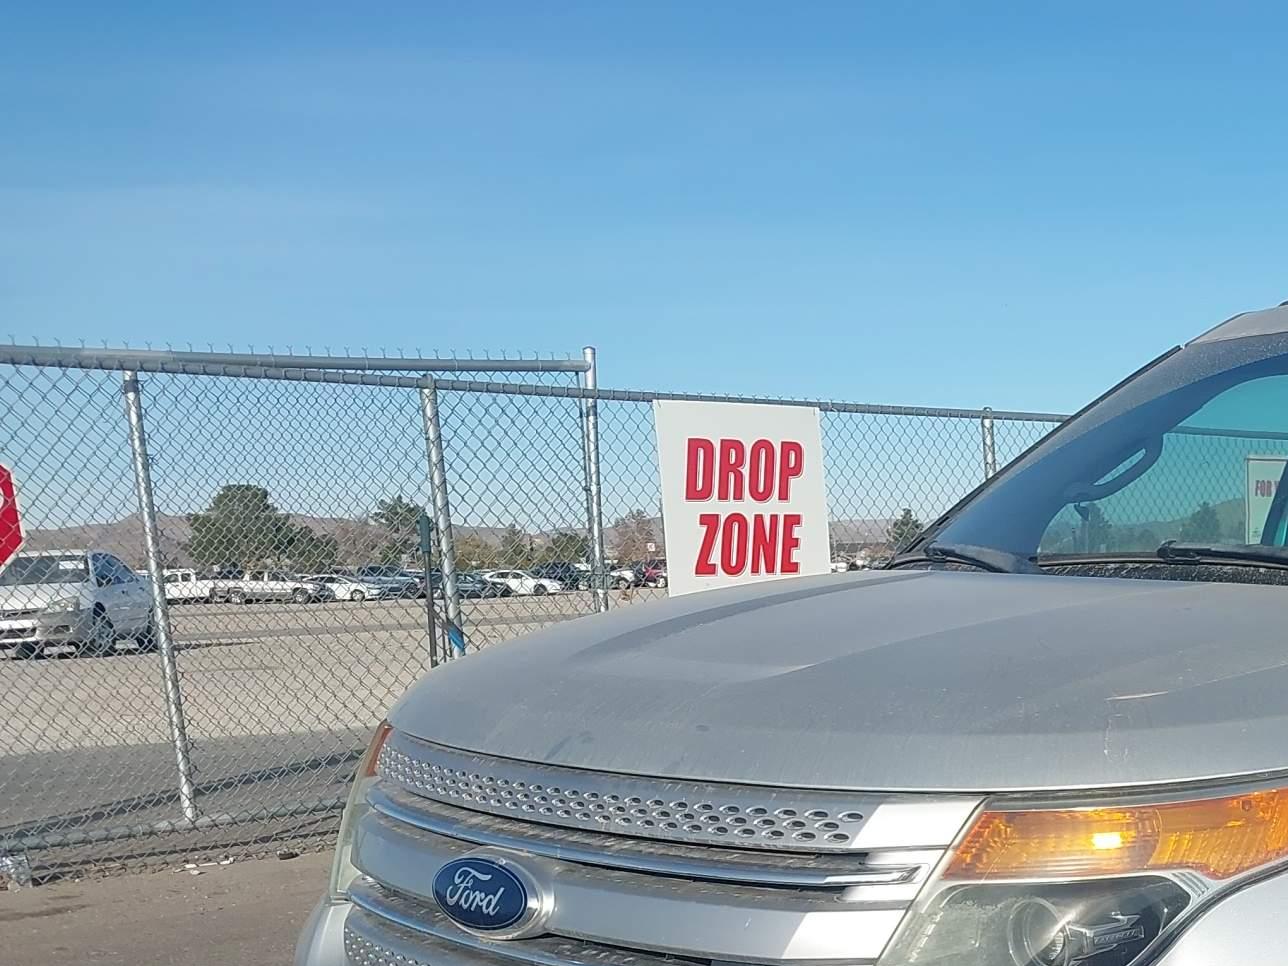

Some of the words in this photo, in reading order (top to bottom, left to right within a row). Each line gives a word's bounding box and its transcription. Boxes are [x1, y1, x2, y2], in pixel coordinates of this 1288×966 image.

[684, 437, 804, 503] DROP
[695, 513, 803, 577] ZONE
[446, 866, 505, 916] Ford
